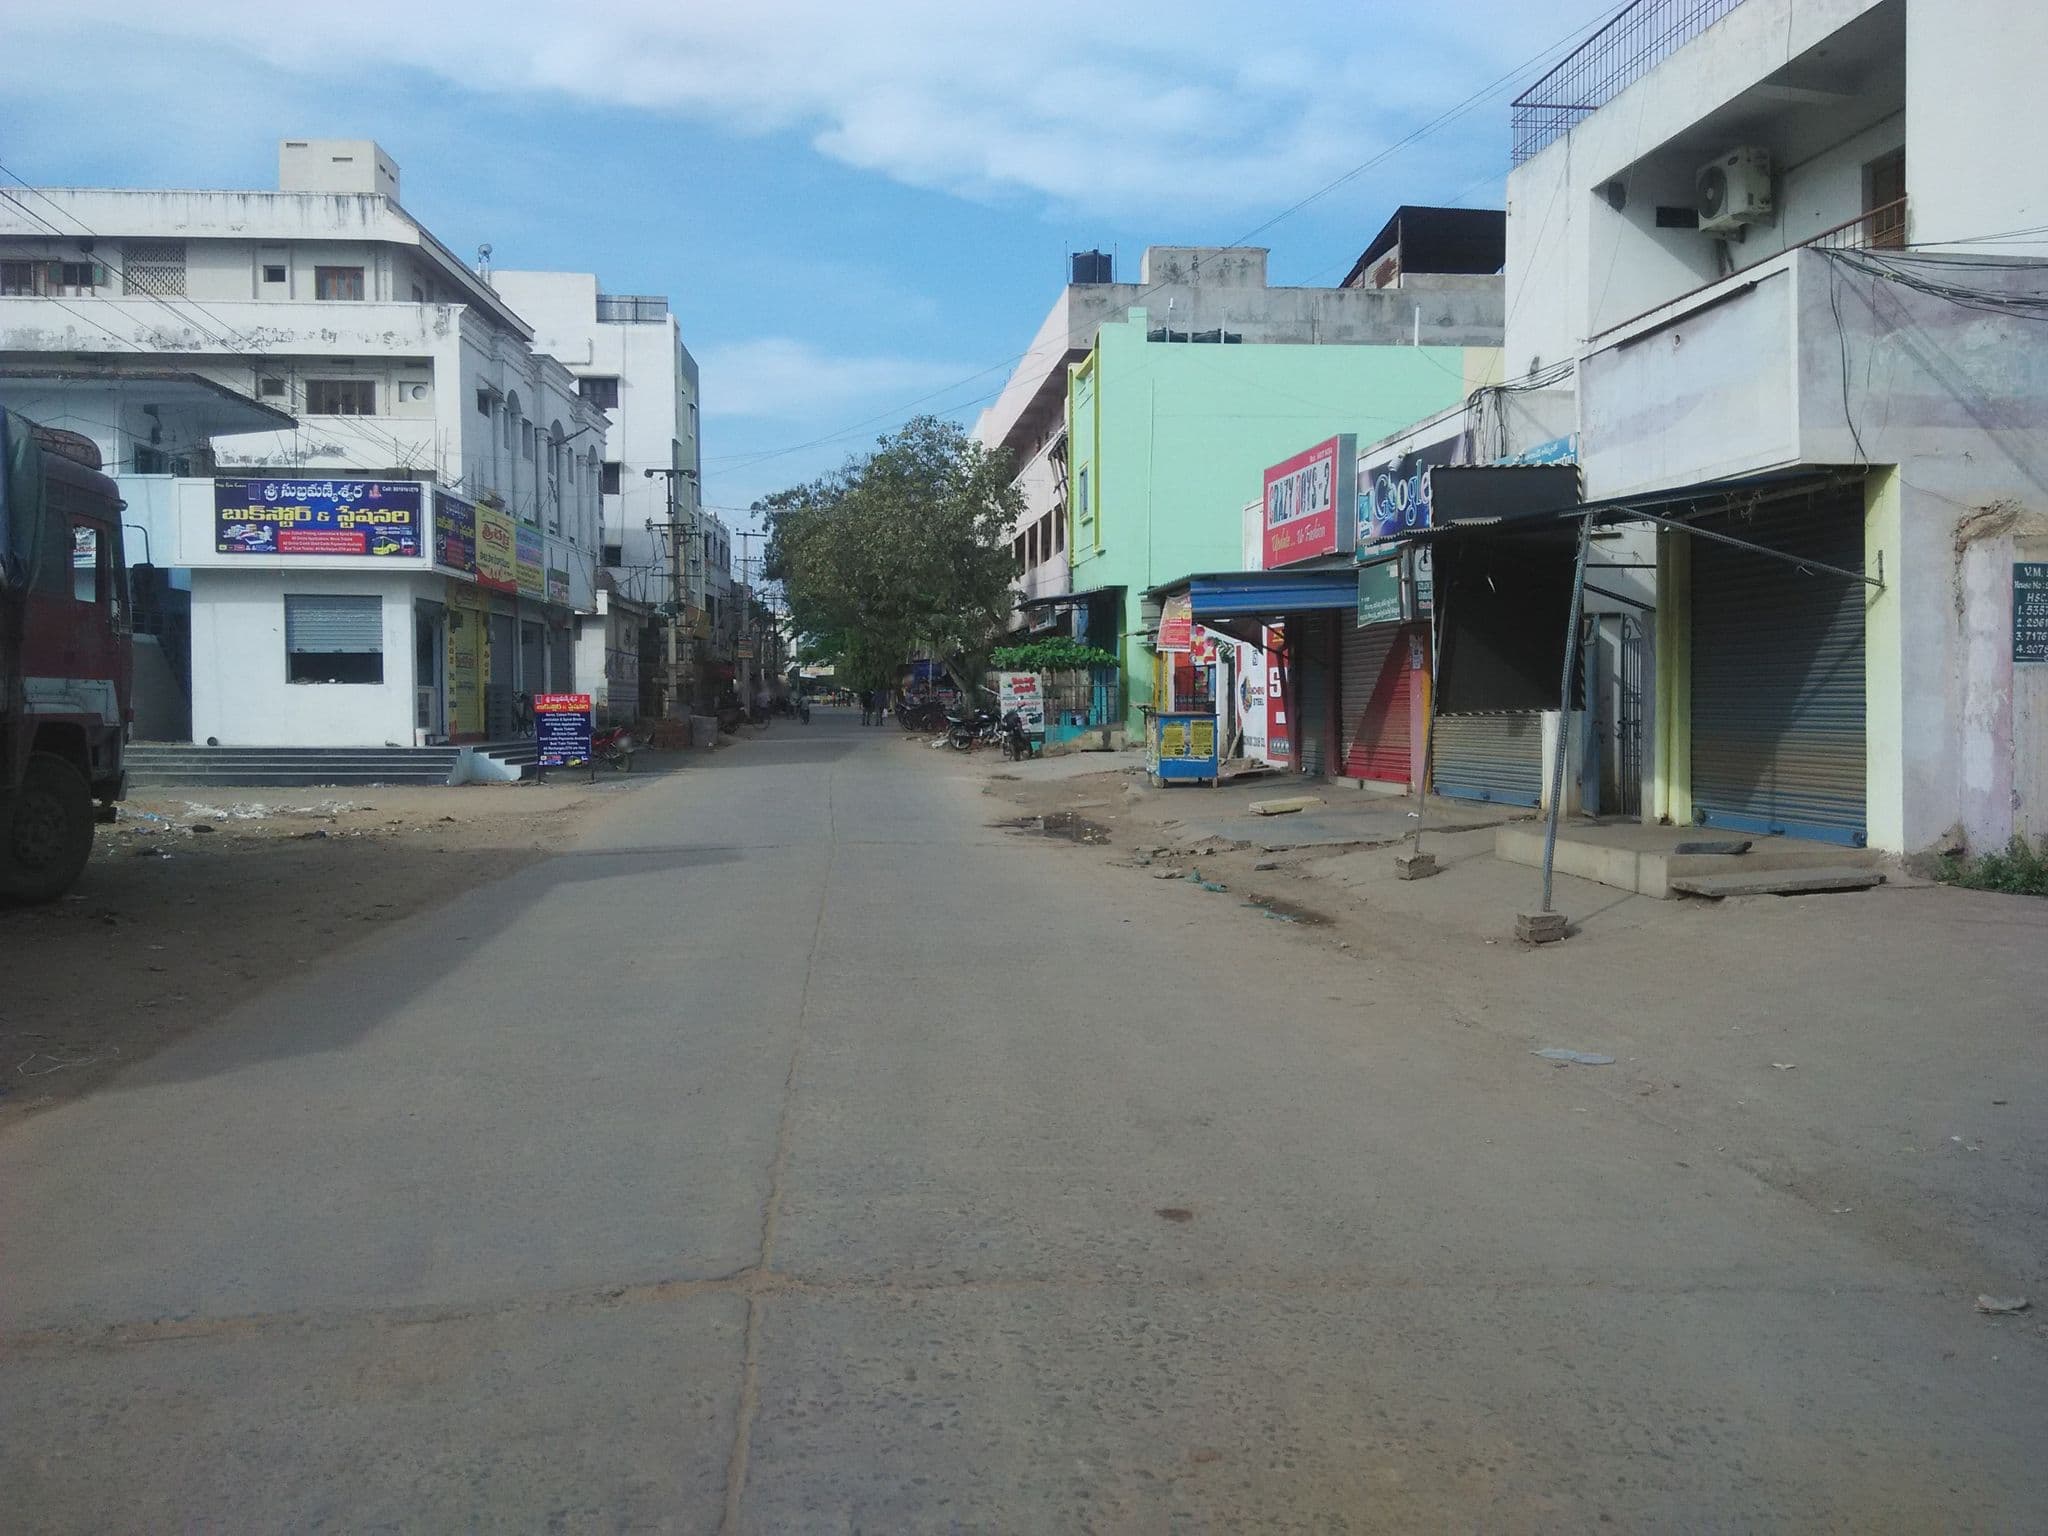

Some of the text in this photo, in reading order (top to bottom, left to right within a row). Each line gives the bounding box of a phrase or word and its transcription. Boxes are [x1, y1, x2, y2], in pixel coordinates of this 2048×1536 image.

[264, 483, 279, 501] శ్రీ
[1269, 476, 1294, 525] CRAZY
[1374, 459, 1432, 526] Google
[317, 512, 330, 522] &
